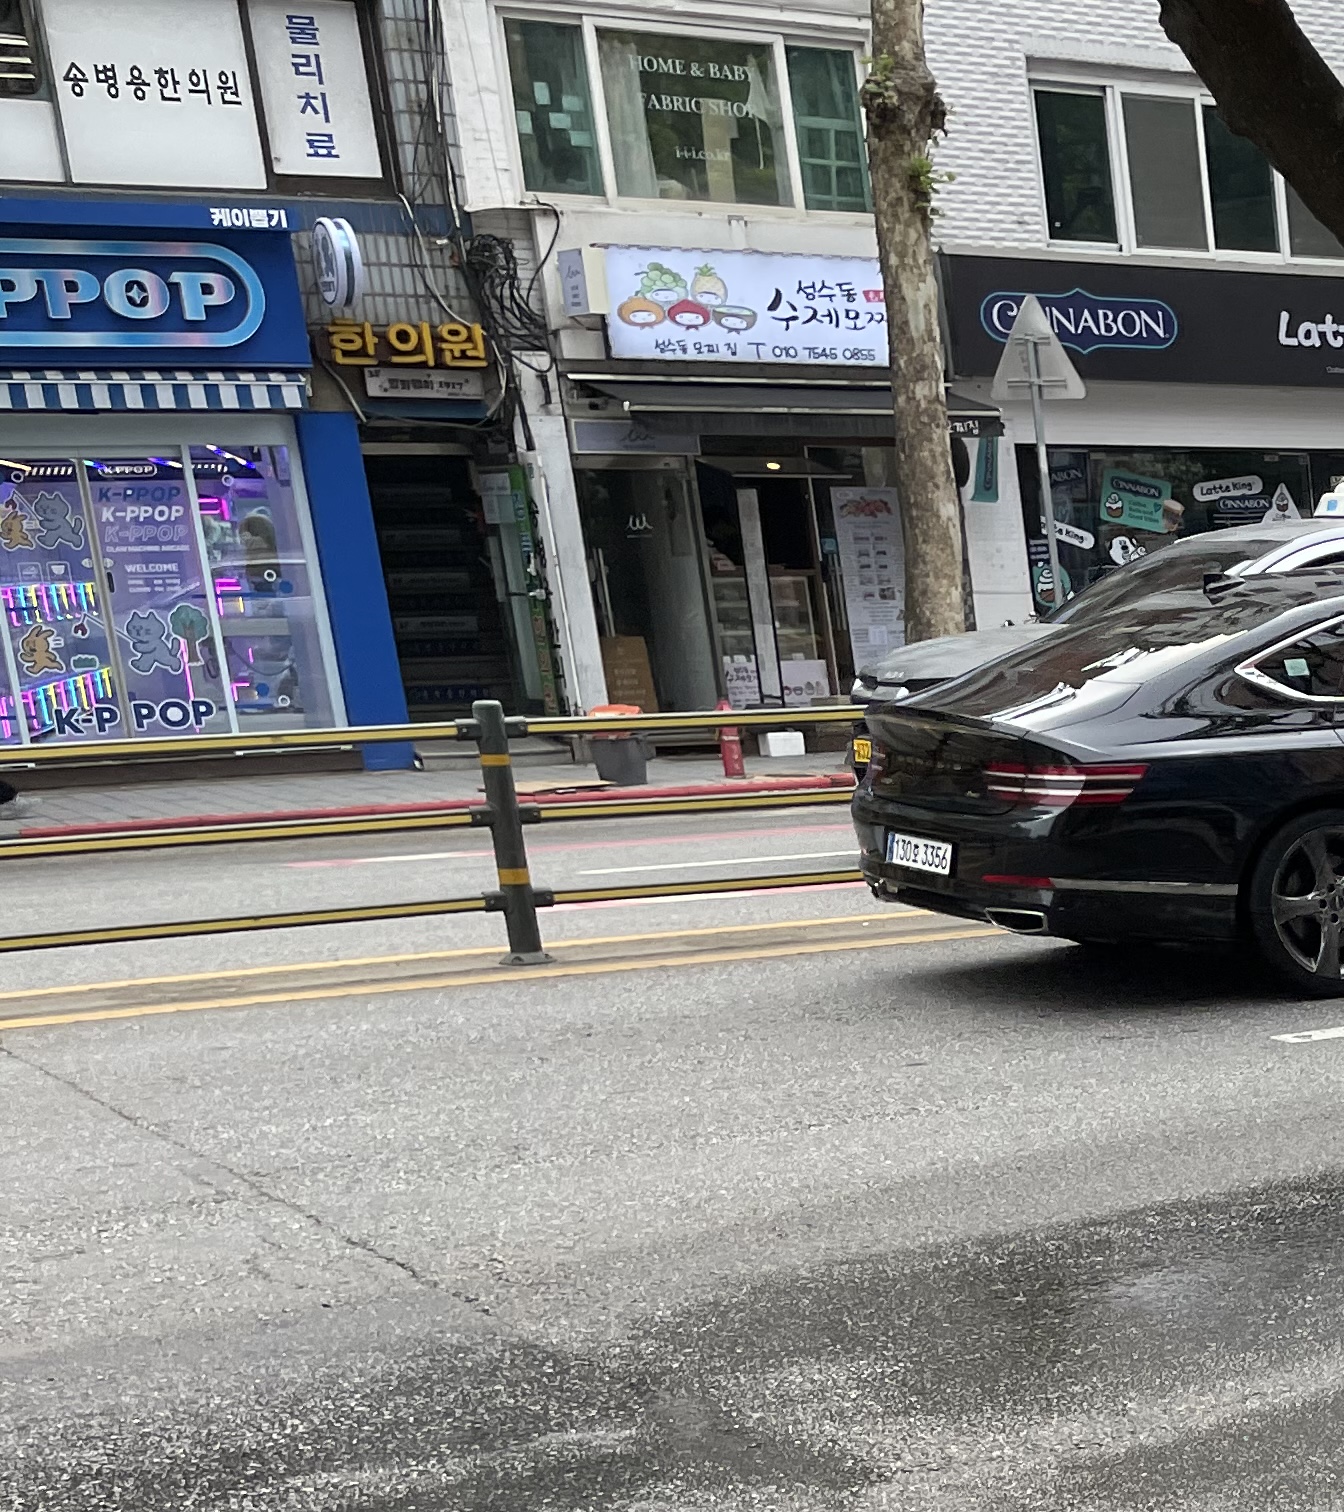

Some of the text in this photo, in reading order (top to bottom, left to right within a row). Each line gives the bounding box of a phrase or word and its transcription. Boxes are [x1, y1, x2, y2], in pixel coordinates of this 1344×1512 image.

[628, 54, 752, 81] HOME & BABY
[62, 61, 243, 106] 송병용한의원
[284, 14, 340, 159] 물리치료
[637, 92, 704, 114] FABRIC
[209, 207, 288, 229] 케이뽑기
[796, 280, 858, 303] 성수동
[991, 300, 1169, 339] CNABON
[327, 317, 490, 367] 한의원
[654, 339, 689, 359] 성수동
[747, 341, 767, 360] T
[771, 344, 799, 359] 010
[842, 346, 877, 362] 0855
[97, 487, 181, 503] K-PPOP
[1200, 479, 1254, 496] Latte King
[101, 506, 184, 522] K-PPOP
[104, 525, 189, 542] K-PPOP
[124, 563, 179, 573] WELCOME
[921, 843, 949, 870] 3356
